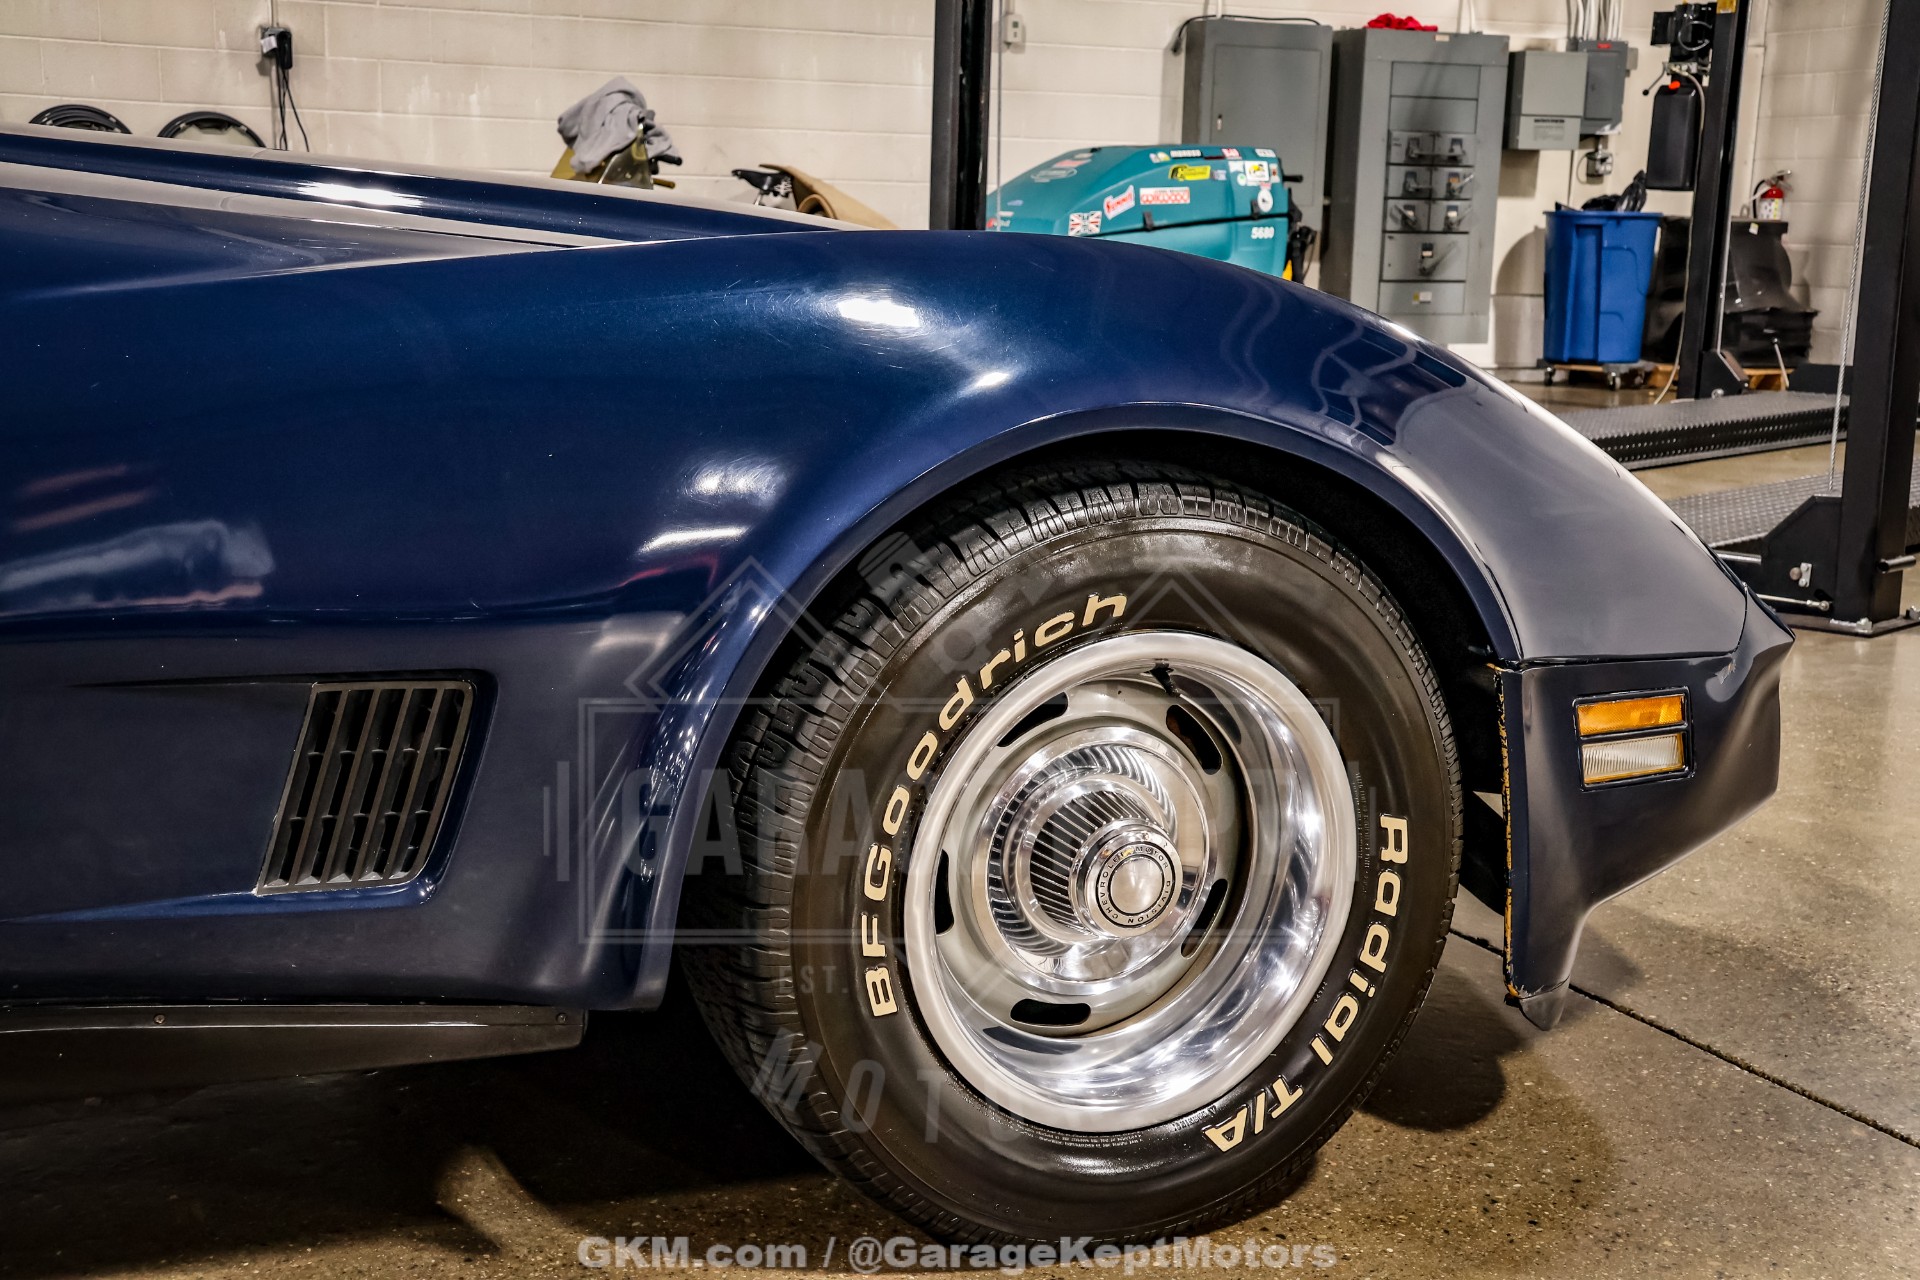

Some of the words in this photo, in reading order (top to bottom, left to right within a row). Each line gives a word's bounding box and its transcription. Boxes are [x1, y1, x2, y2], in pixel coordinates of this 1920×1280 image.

[861, 592, 1128, 1018] BFGoodrich
[1135, 846, 1169, 869] MOTOR
[1127, 880, 1171, 924] DIVISION
[1310, 812, 1409, 1066] Radial
[1203, 1074, 1304, 1152] T/A
